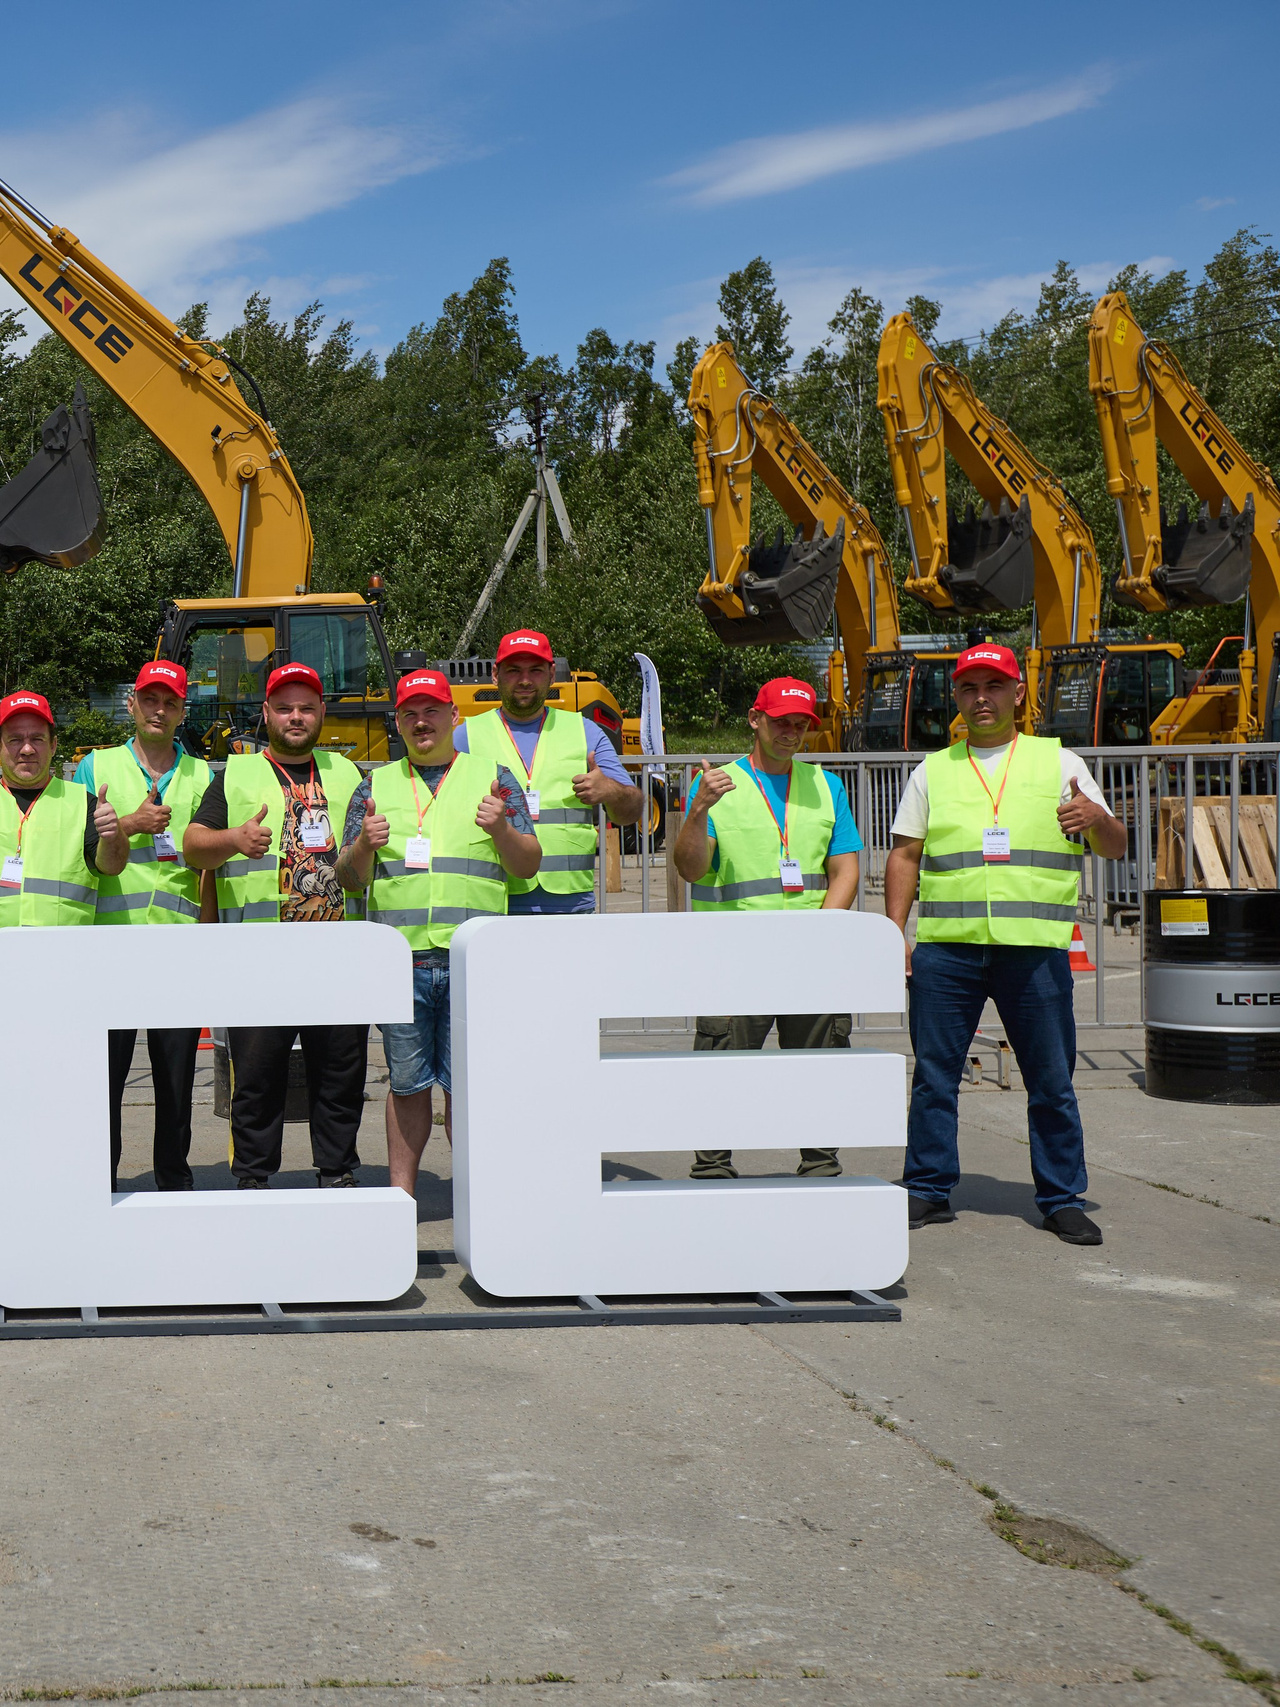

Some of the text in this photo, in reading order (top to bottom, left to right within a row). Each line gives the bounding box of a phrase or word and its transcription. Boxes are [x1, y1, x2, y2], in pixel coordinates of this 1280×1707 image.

[18, 253, 134, 364] LGCE
[1180, 401, 1235, 476] LGCE
[969, 421, 1027, 496] LGCE
[774, 439, 824, 505] LGCE
[509, 637, 539, 646] LGCE
[967, 652, 1002, 661] LGCE
[150, 667, 178, 679] LGCE
[406, 677, 436, 687] LGCE
[781, 688, 811, 701] LGCE
[10, 698, 39, 707] LGCE
[623, 735, 640, 745] CE
[1216, 992, 1280, 1006] LGCE
